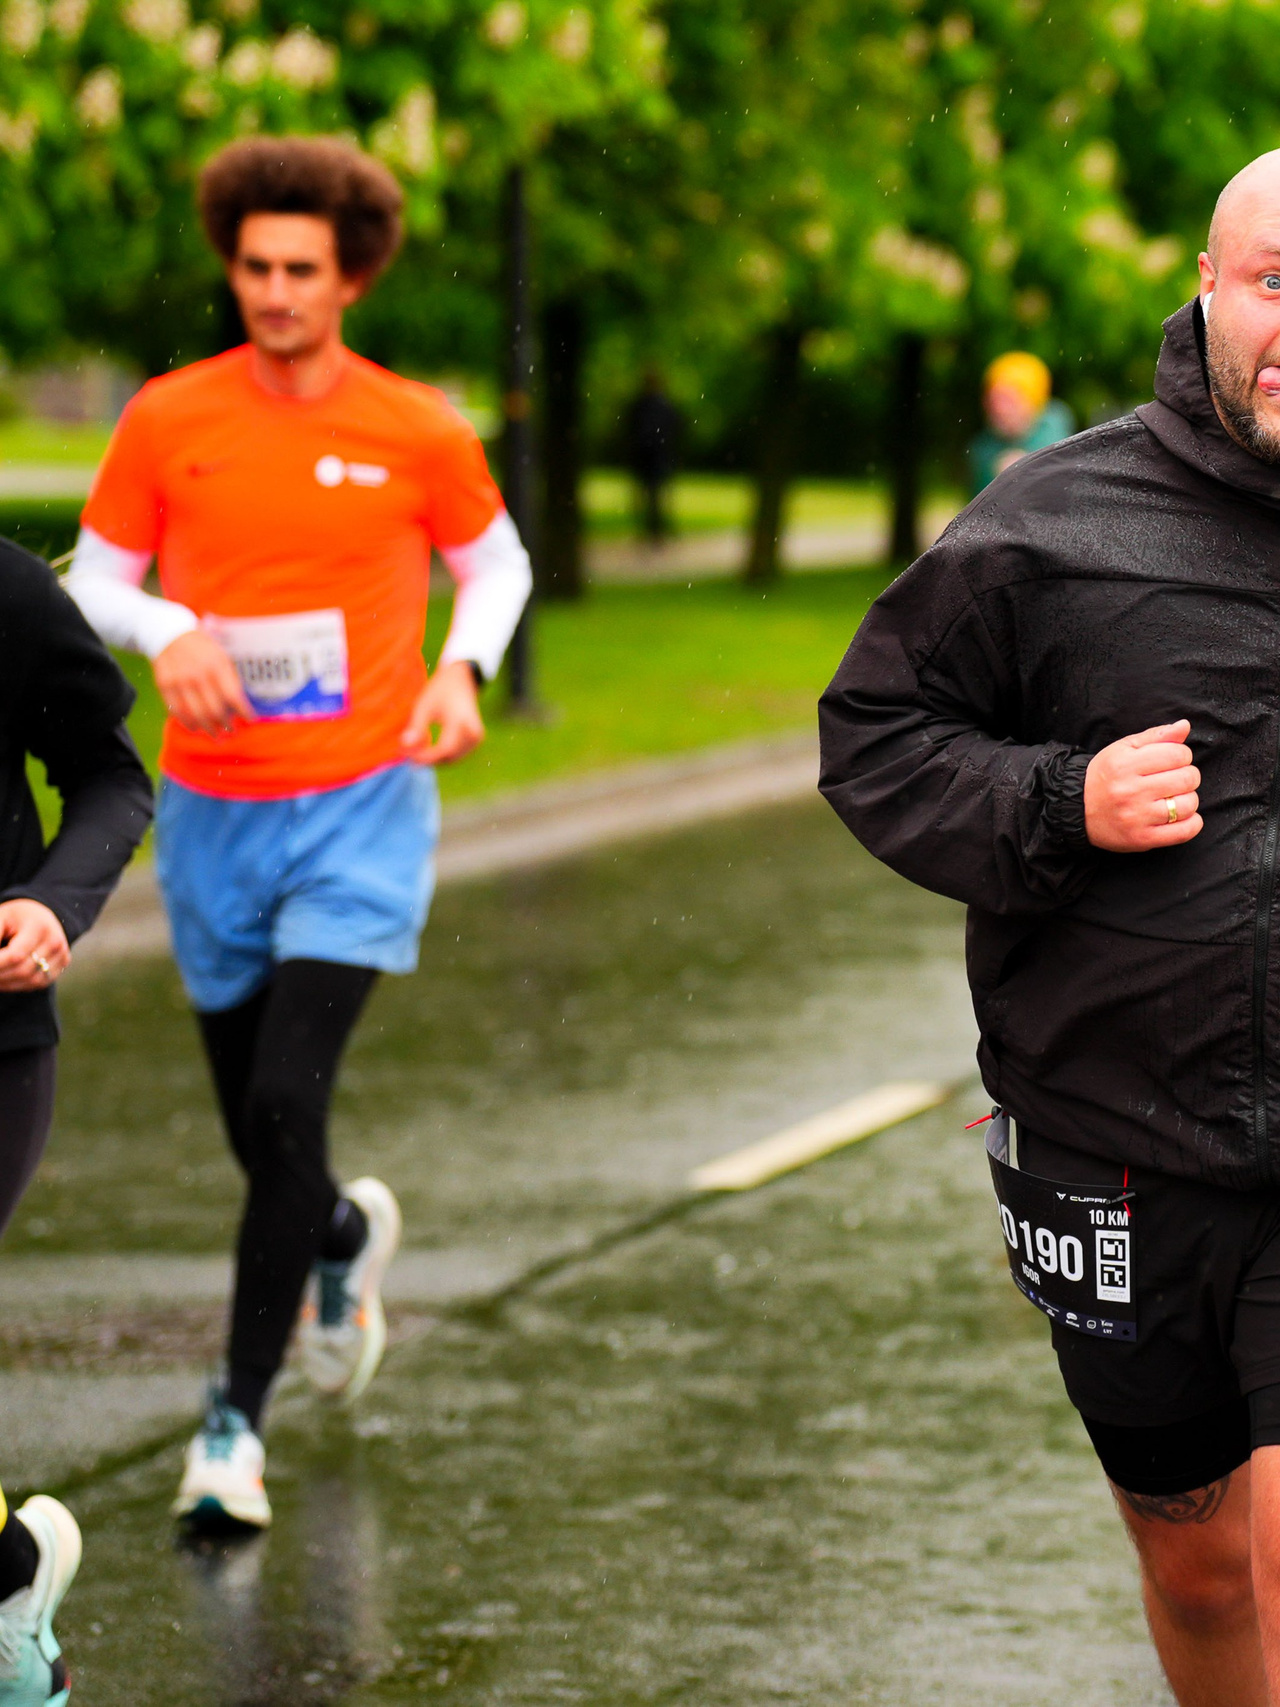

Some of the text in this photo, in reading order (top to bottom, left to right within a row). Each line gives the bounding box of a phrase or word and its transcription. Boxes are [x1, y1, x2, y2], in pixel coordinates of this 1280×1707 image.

[1089, 1209, 1129, 1227] 10 KM
[997, 1202, 1084, 1282] 0190
[1021, 1262, 1041, 1286] IGOR
